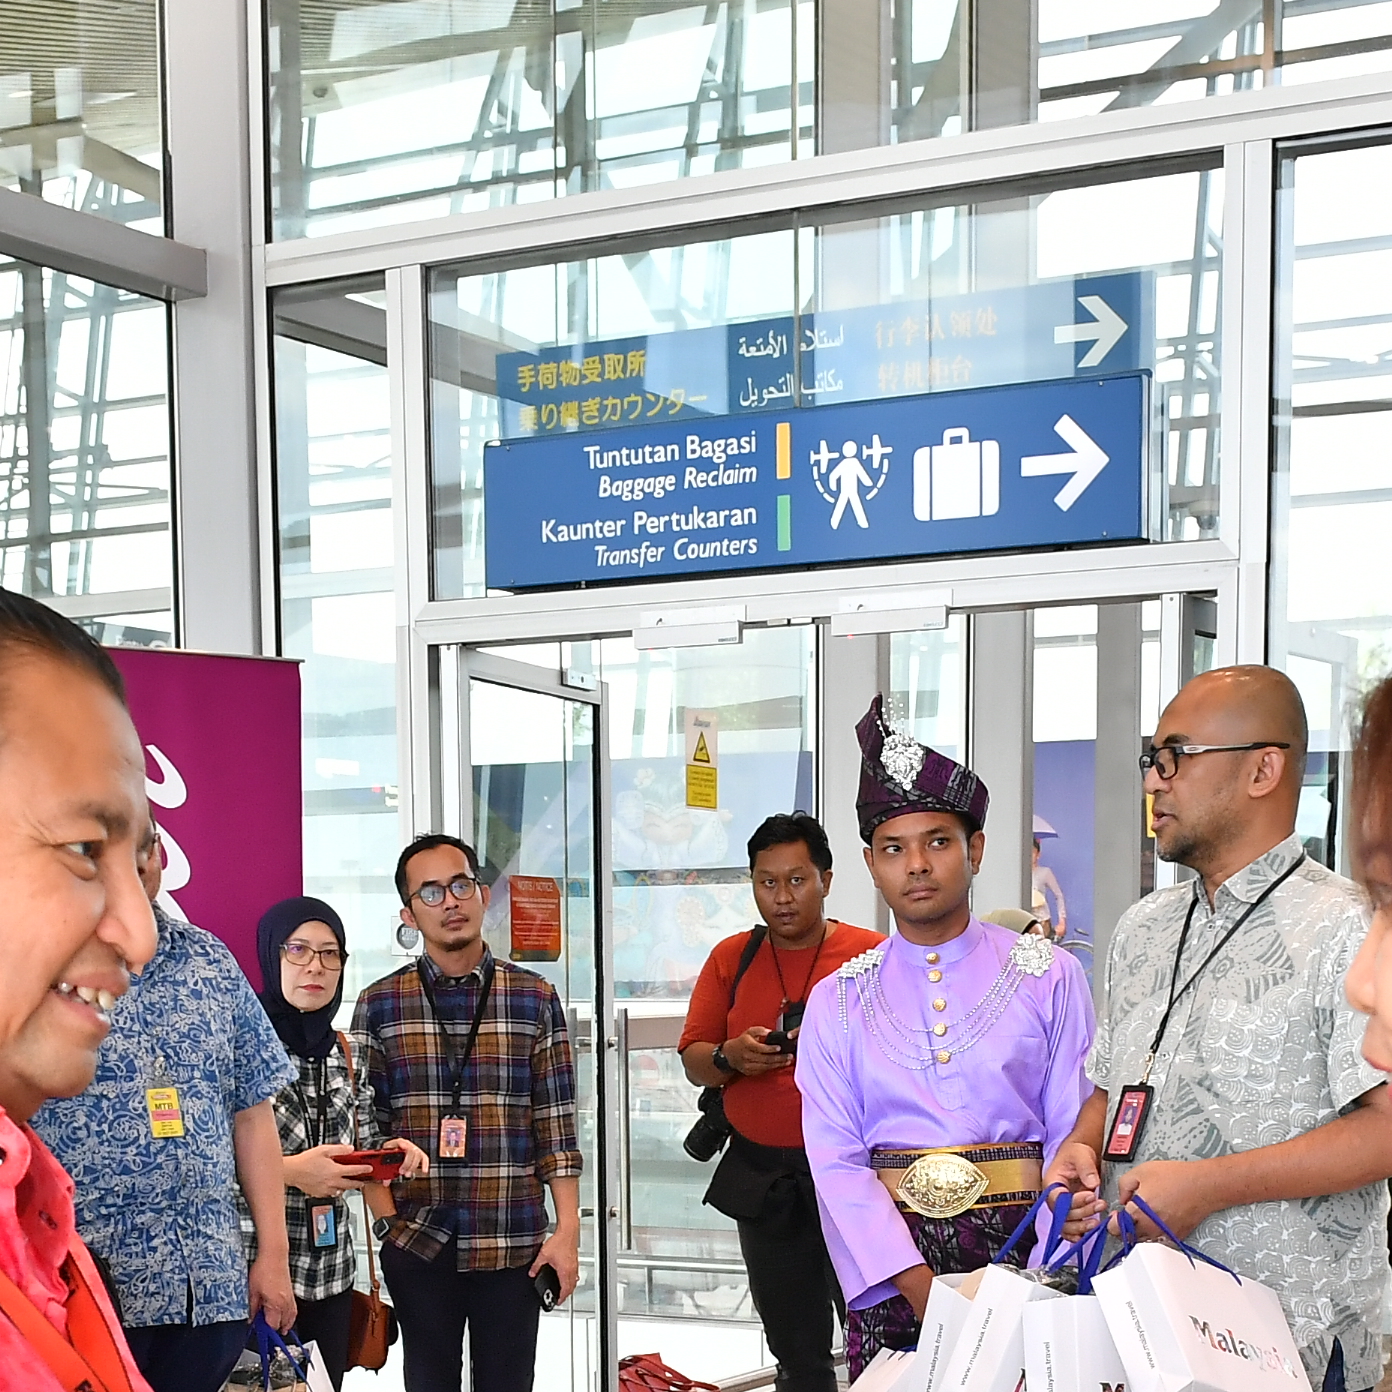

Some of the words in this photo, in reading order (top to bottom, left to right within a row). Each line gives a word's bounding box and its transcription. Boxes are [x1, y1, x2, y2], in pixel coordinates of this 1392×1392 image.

[517, 350, 646, 392] 手荷物受取所
[518, 388, 707, 431] 乗り継ぎカウンター
[583, 443, 680, 469] Tuntutan
[686, 430, 756, 464] Bagasi
[598, 475, 676, 501] Baggage
[683, 464, 757, 489] Reclaim
[541, 518, 626, 544] Kaunter
[633, 505, 757, 535] Pertukaran
[594, 541, 665, 568] Transfer
[673, 537, 757, 561] Counters
[154, 1102, 174, 1110] MTB
[960, 1307, 994, 1386] www.malaysia.travel
[1125, 1300, 1156, 1370] www.malaysia.travel
[1188, 1314, 1298, 1379] Malaysia
